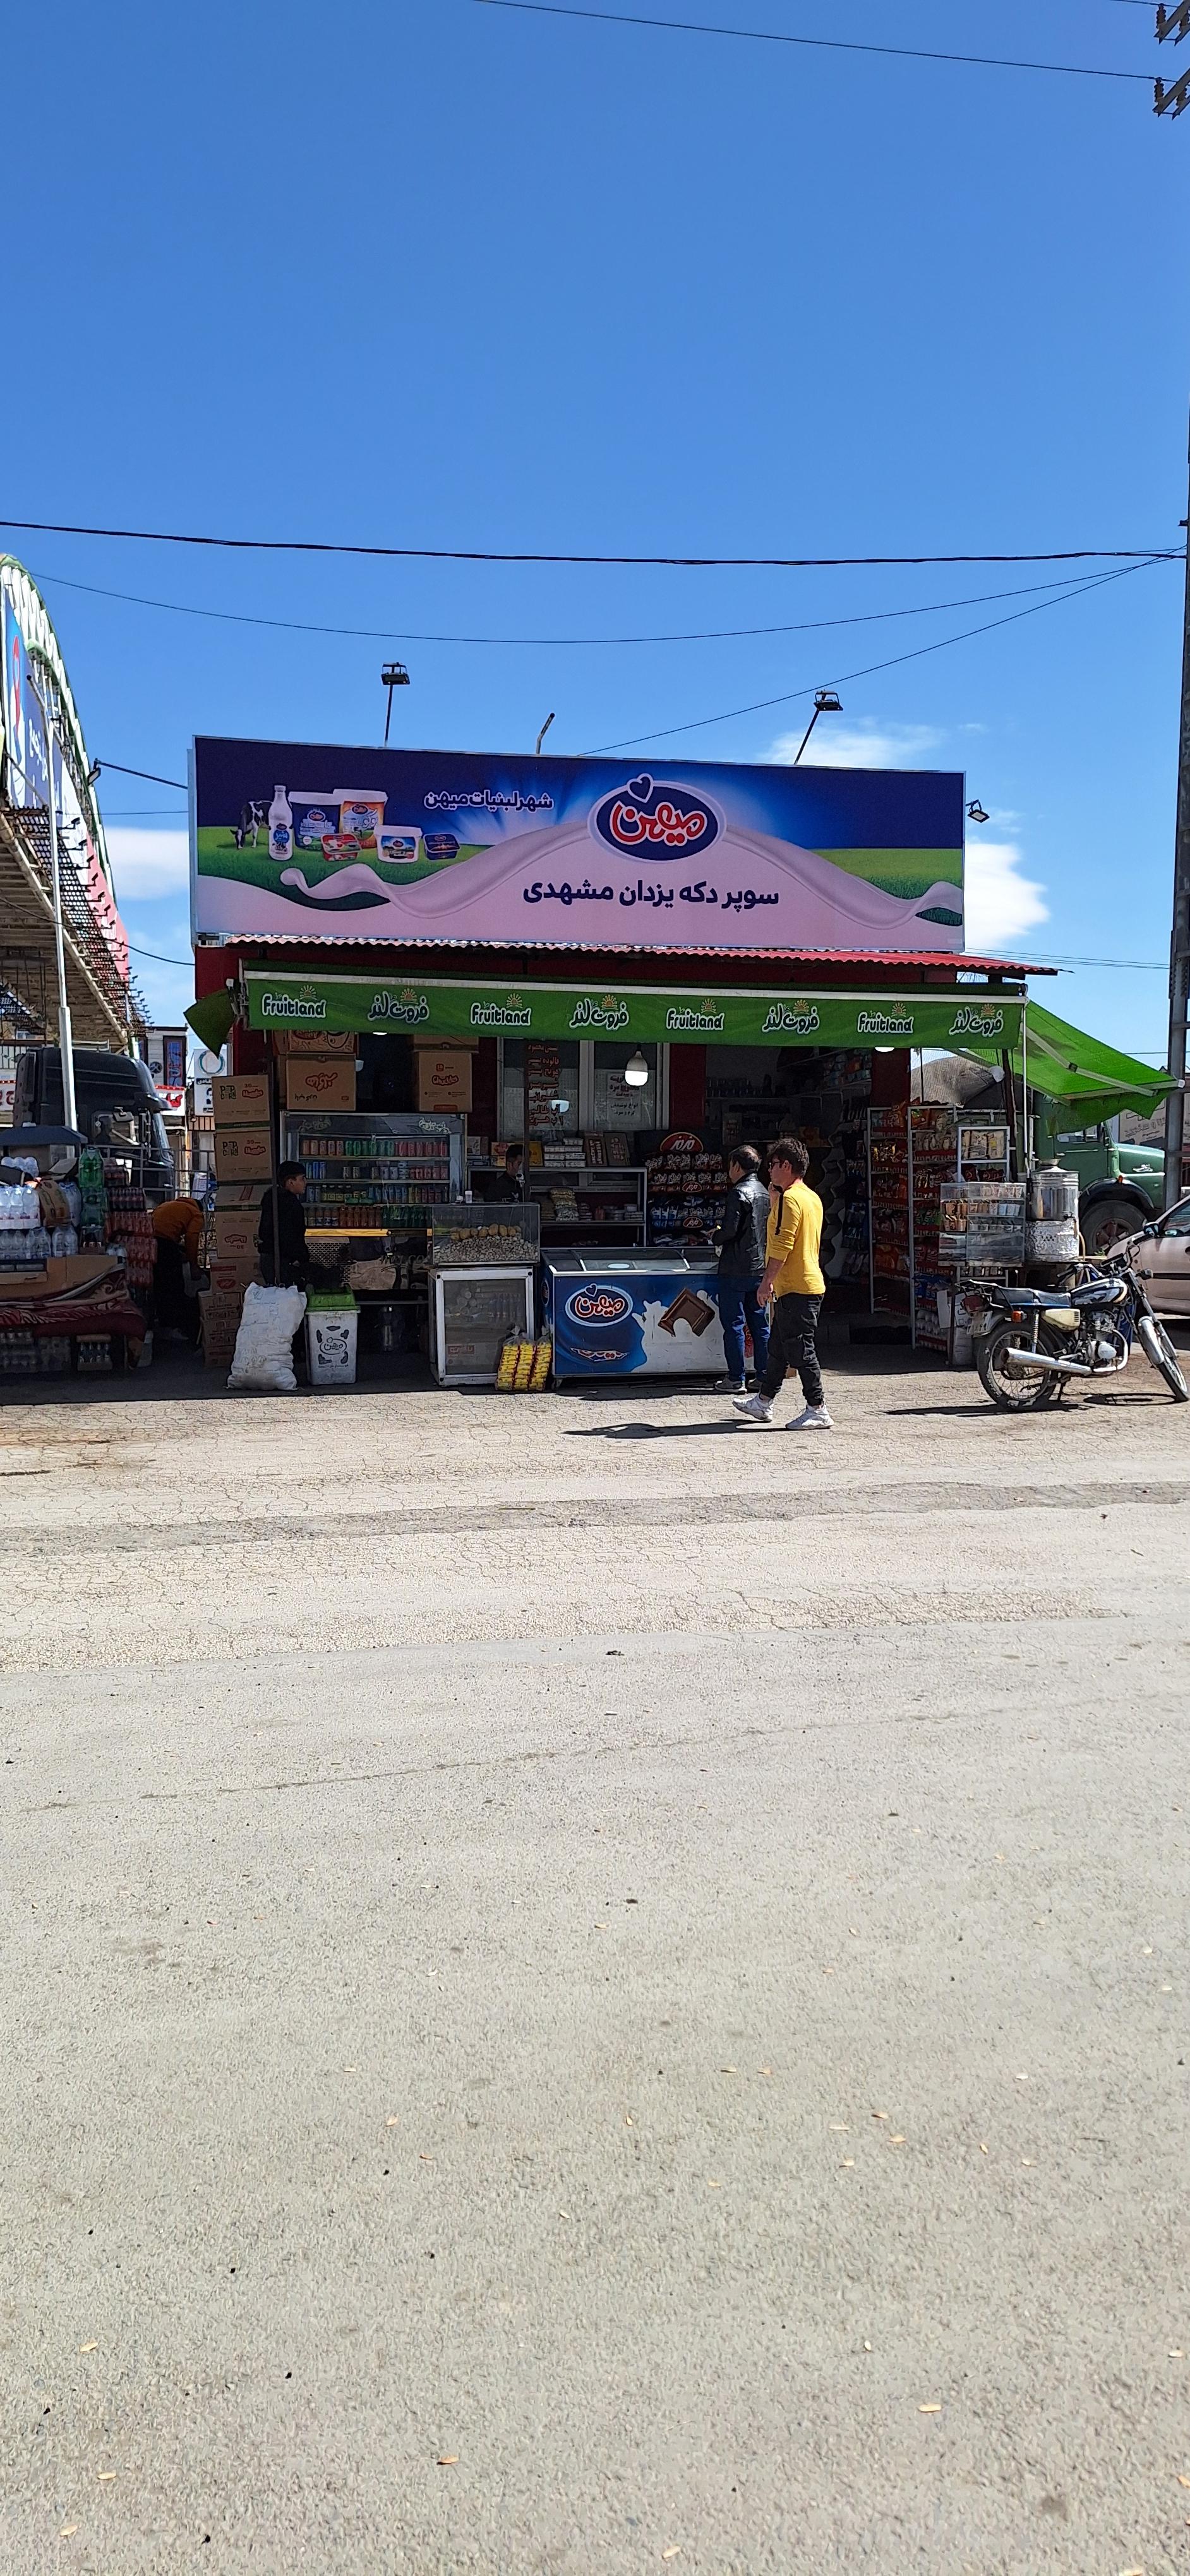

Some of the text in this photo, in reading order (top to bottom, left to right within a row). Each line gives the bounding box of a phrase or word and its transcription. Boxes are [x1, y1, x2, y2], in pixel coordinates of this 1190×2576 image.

[424, 790, 554, 813] شهر لبنیات میهن
[612, 800, 707, 845] میهن
[524, 880, 779, 912] سوپر دکه یزدان مشهدی
[262, 993, 326, 1018] Fruitland
[471, 1002, 531, 1026] Fruitland
[666, 1008, 724, 1030] Fruitland
[858, 1012, 914, 1034] Fruitland
[575, 1295, 625, 1318] میهن
